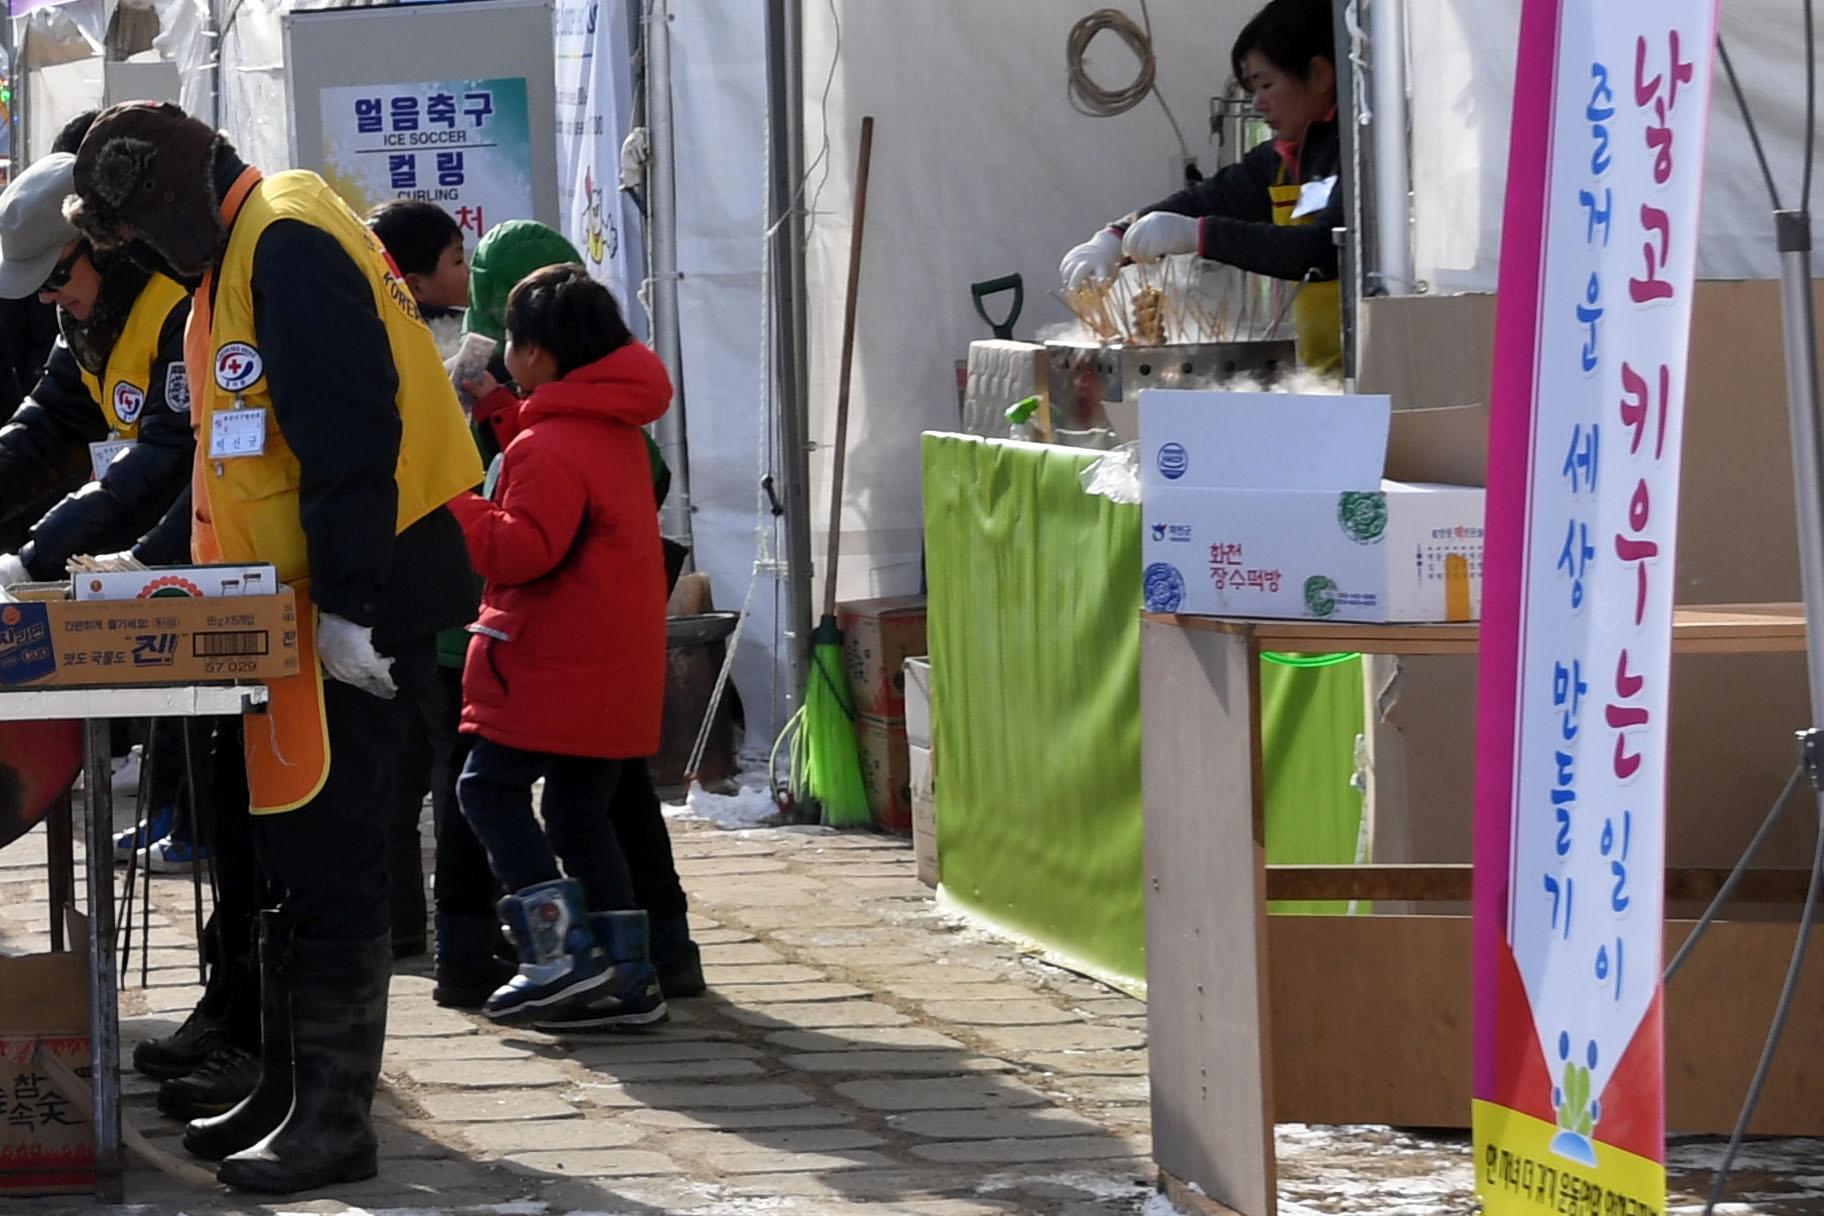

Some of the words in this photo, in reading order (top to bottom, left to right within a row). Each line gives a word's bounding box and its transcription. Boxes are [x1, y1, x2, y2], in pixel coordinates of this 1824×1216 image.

[355, 92, 493, 133] 얼음축구
[384, 133, 406, 146] ICE
[409, 130, 467, 145] SOCCER
[388, 151, 465, 189] 컬링
[397, 188, 459, 203] CURLING
[1629, 30, 1694, 304] 낳고
[1576, 62, 1615, 372] 즐거운
[1209, 543, 1242, 565] 화천
[1558, 422, 1600, 609] 세상
[1605, 361, 1670, 780] 키우는
[1543, 659, 1588, 940] 만들기
[1595, 810, 1632, 1002] 일이
